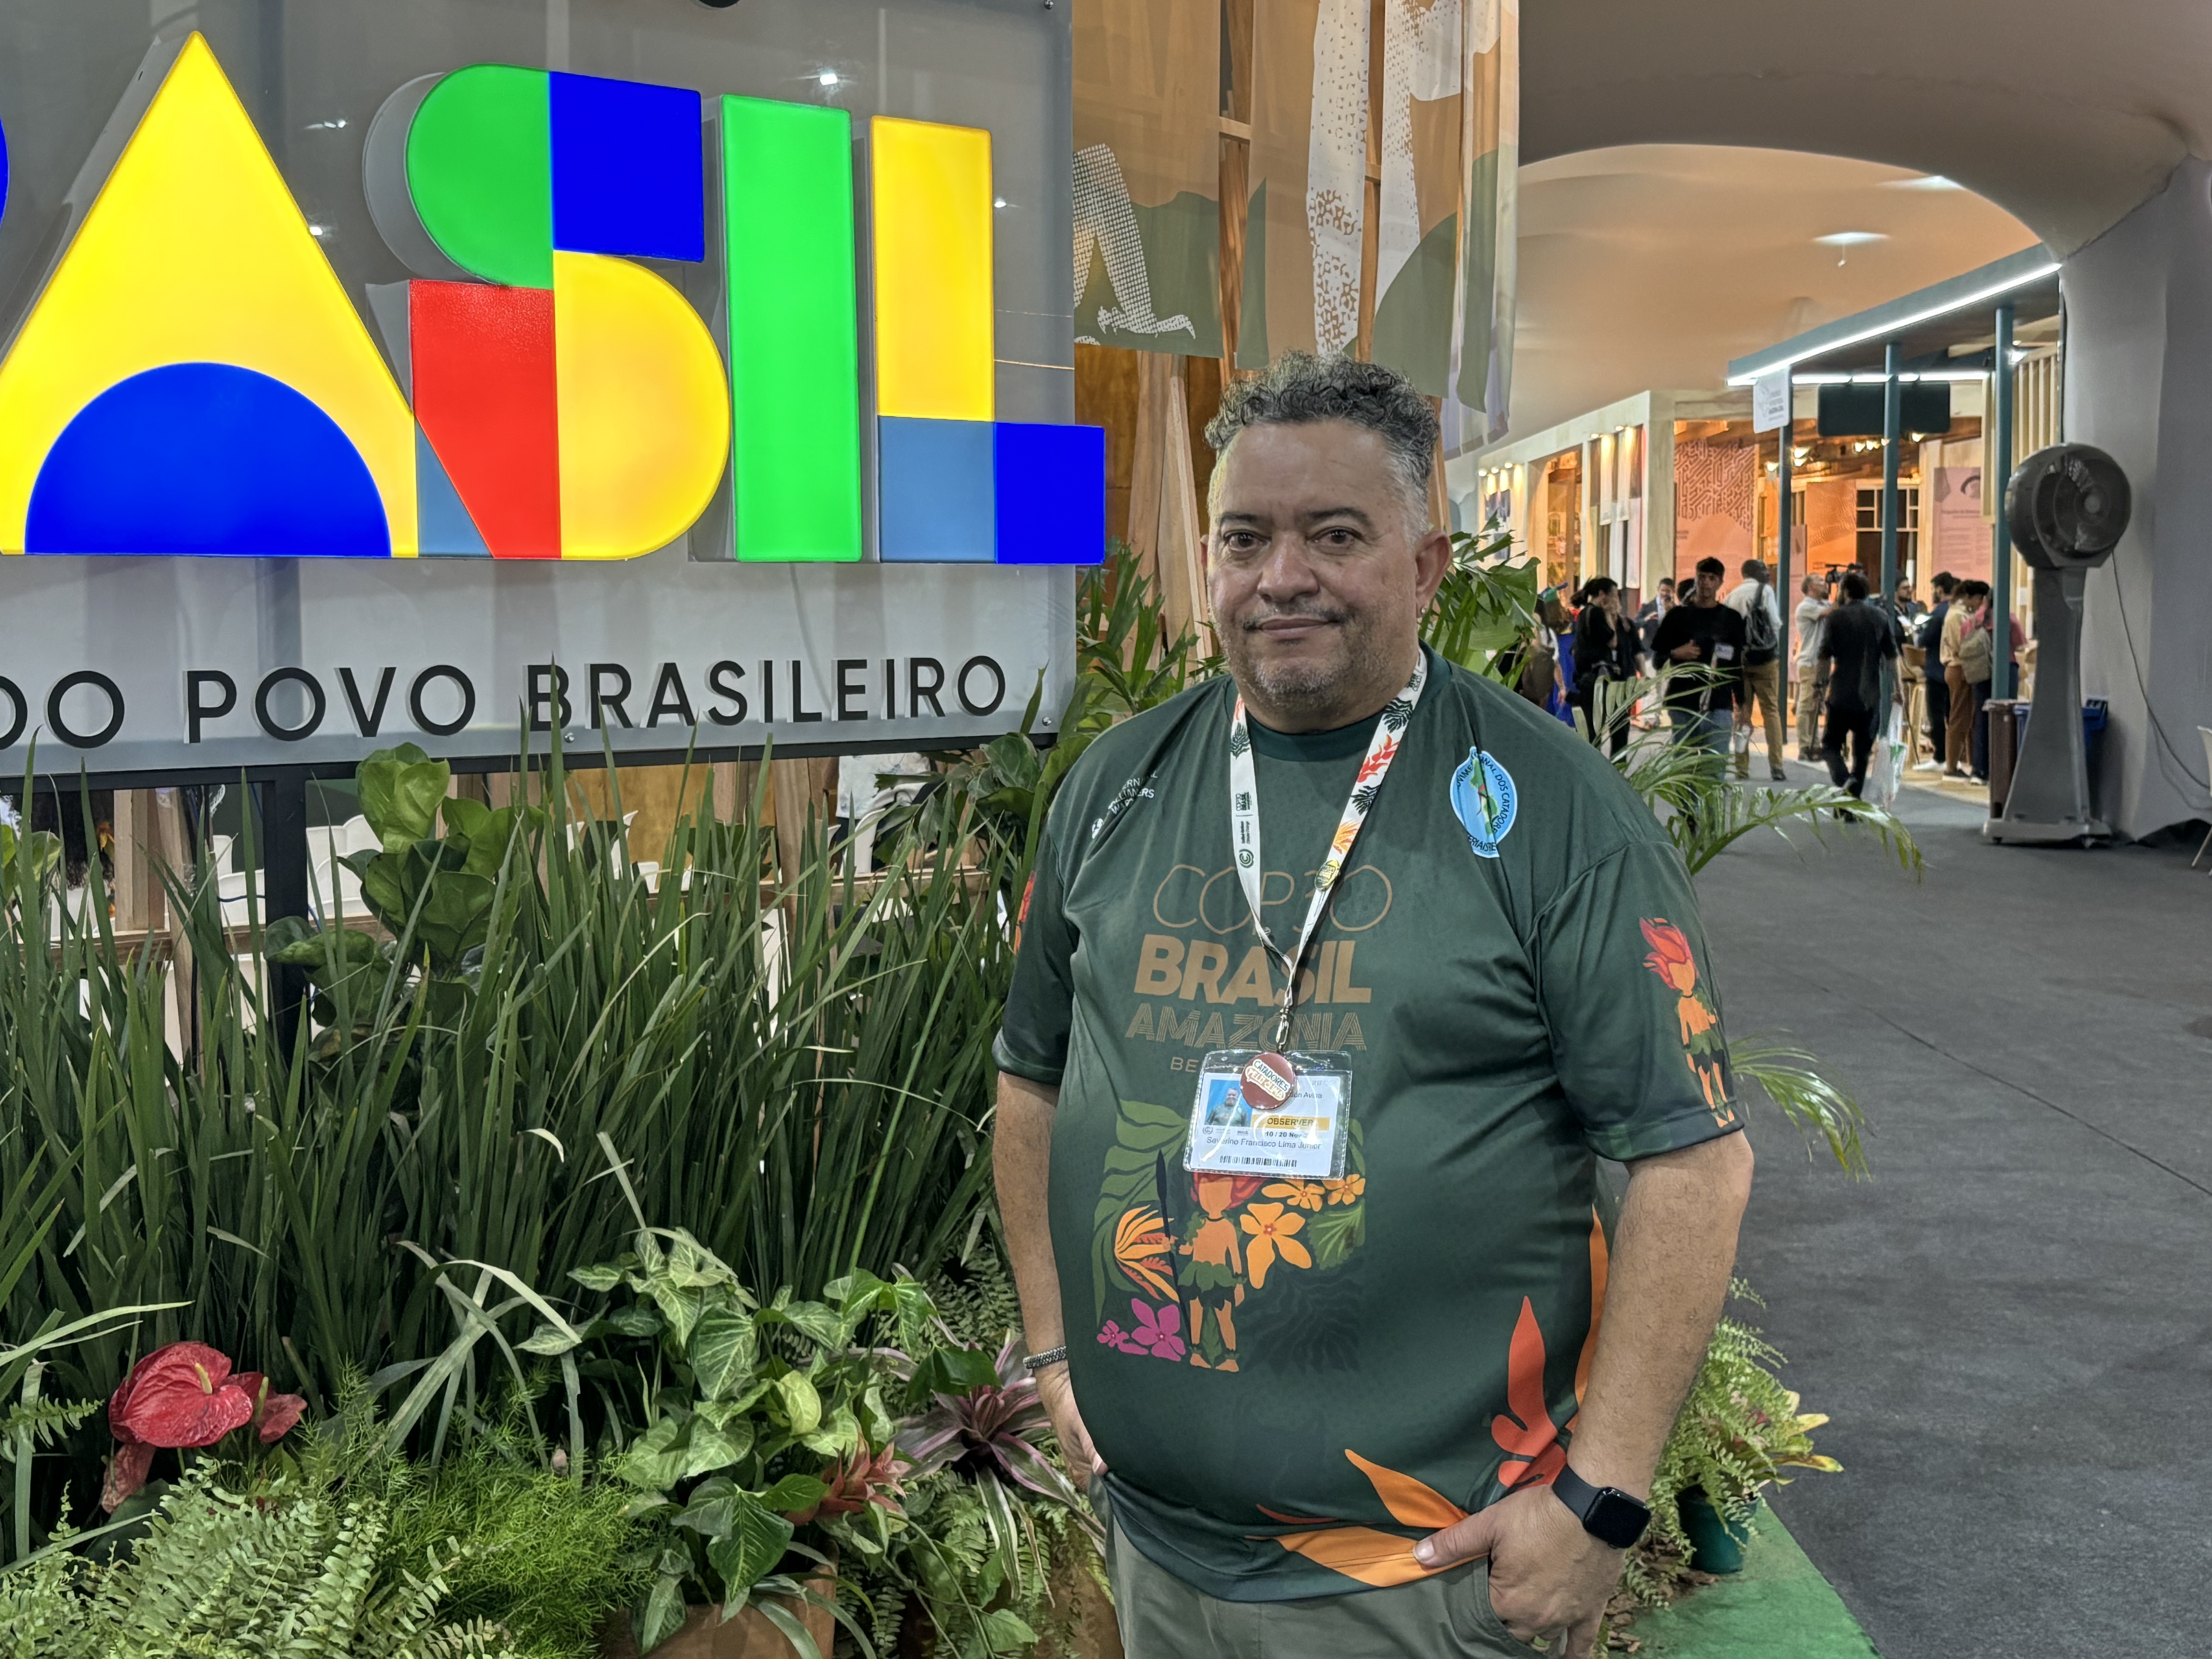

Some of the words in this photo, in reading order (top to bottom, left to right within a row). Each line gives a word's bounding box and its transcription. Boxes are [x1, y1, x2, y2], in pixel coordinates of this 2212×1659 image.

[0, 31, 1106, 565] ASIL
[187, 665, 476, 743] POVO
[527, 656, 1006, 731] BRASILEIRO
[1496, 775, 1508, 791] DOS
[1134, 934, 1372, 1007] BRASIL
[1254, 1060, 1289, 1092] CATADORES
[1264, 1080, 1284, 1099] CLIMA
[1267, 1118, 1314, 1127] OBSERVER
